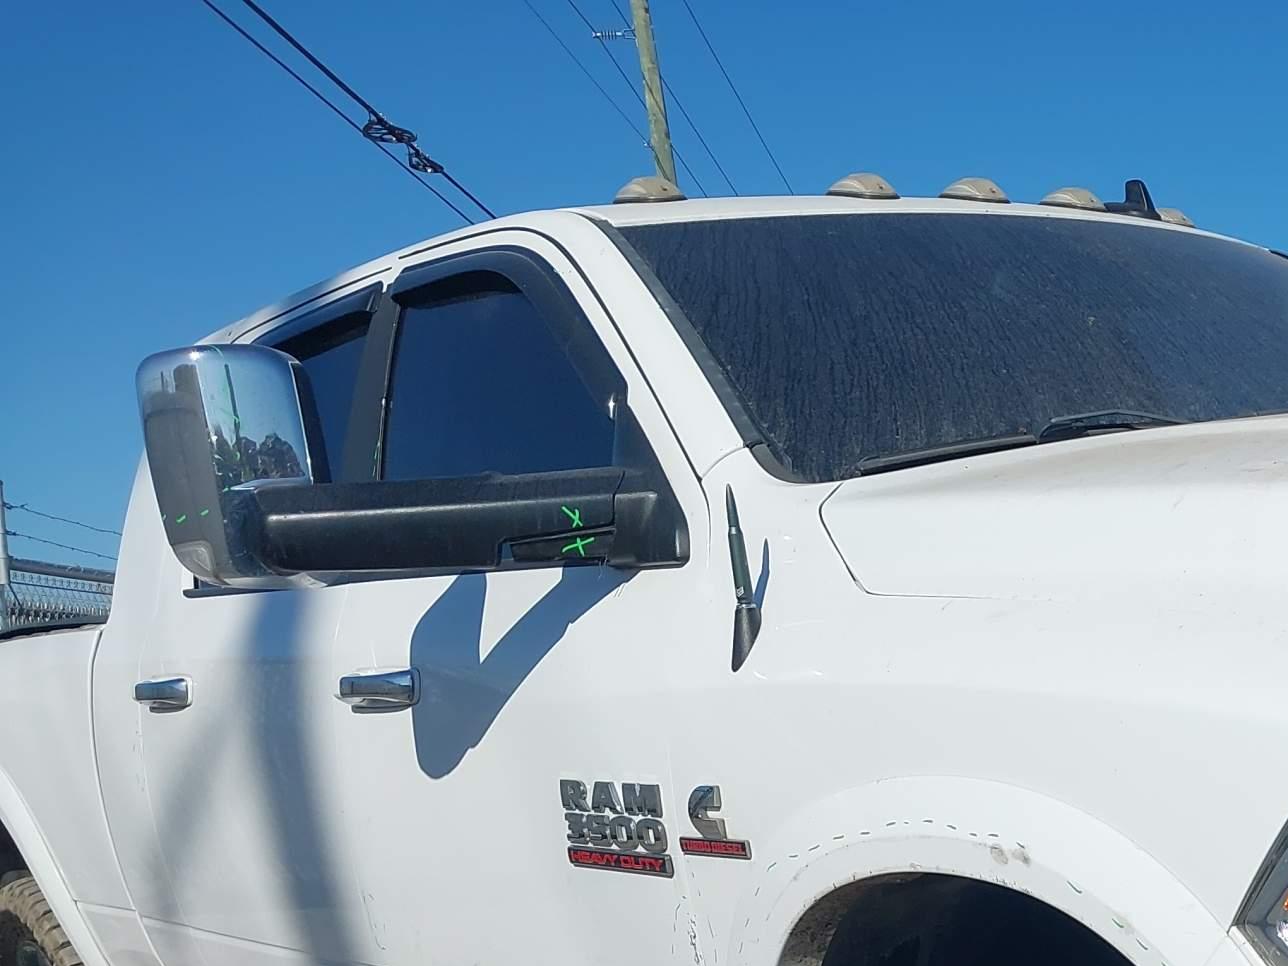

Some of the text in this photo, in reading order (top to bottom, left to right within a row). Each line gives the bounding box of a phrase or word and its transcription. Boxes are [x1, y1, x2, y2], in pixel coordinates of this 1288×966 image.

[560, 779, 664, 818] RAM
[571, 850, 663, 872] HEAVY DUTY
